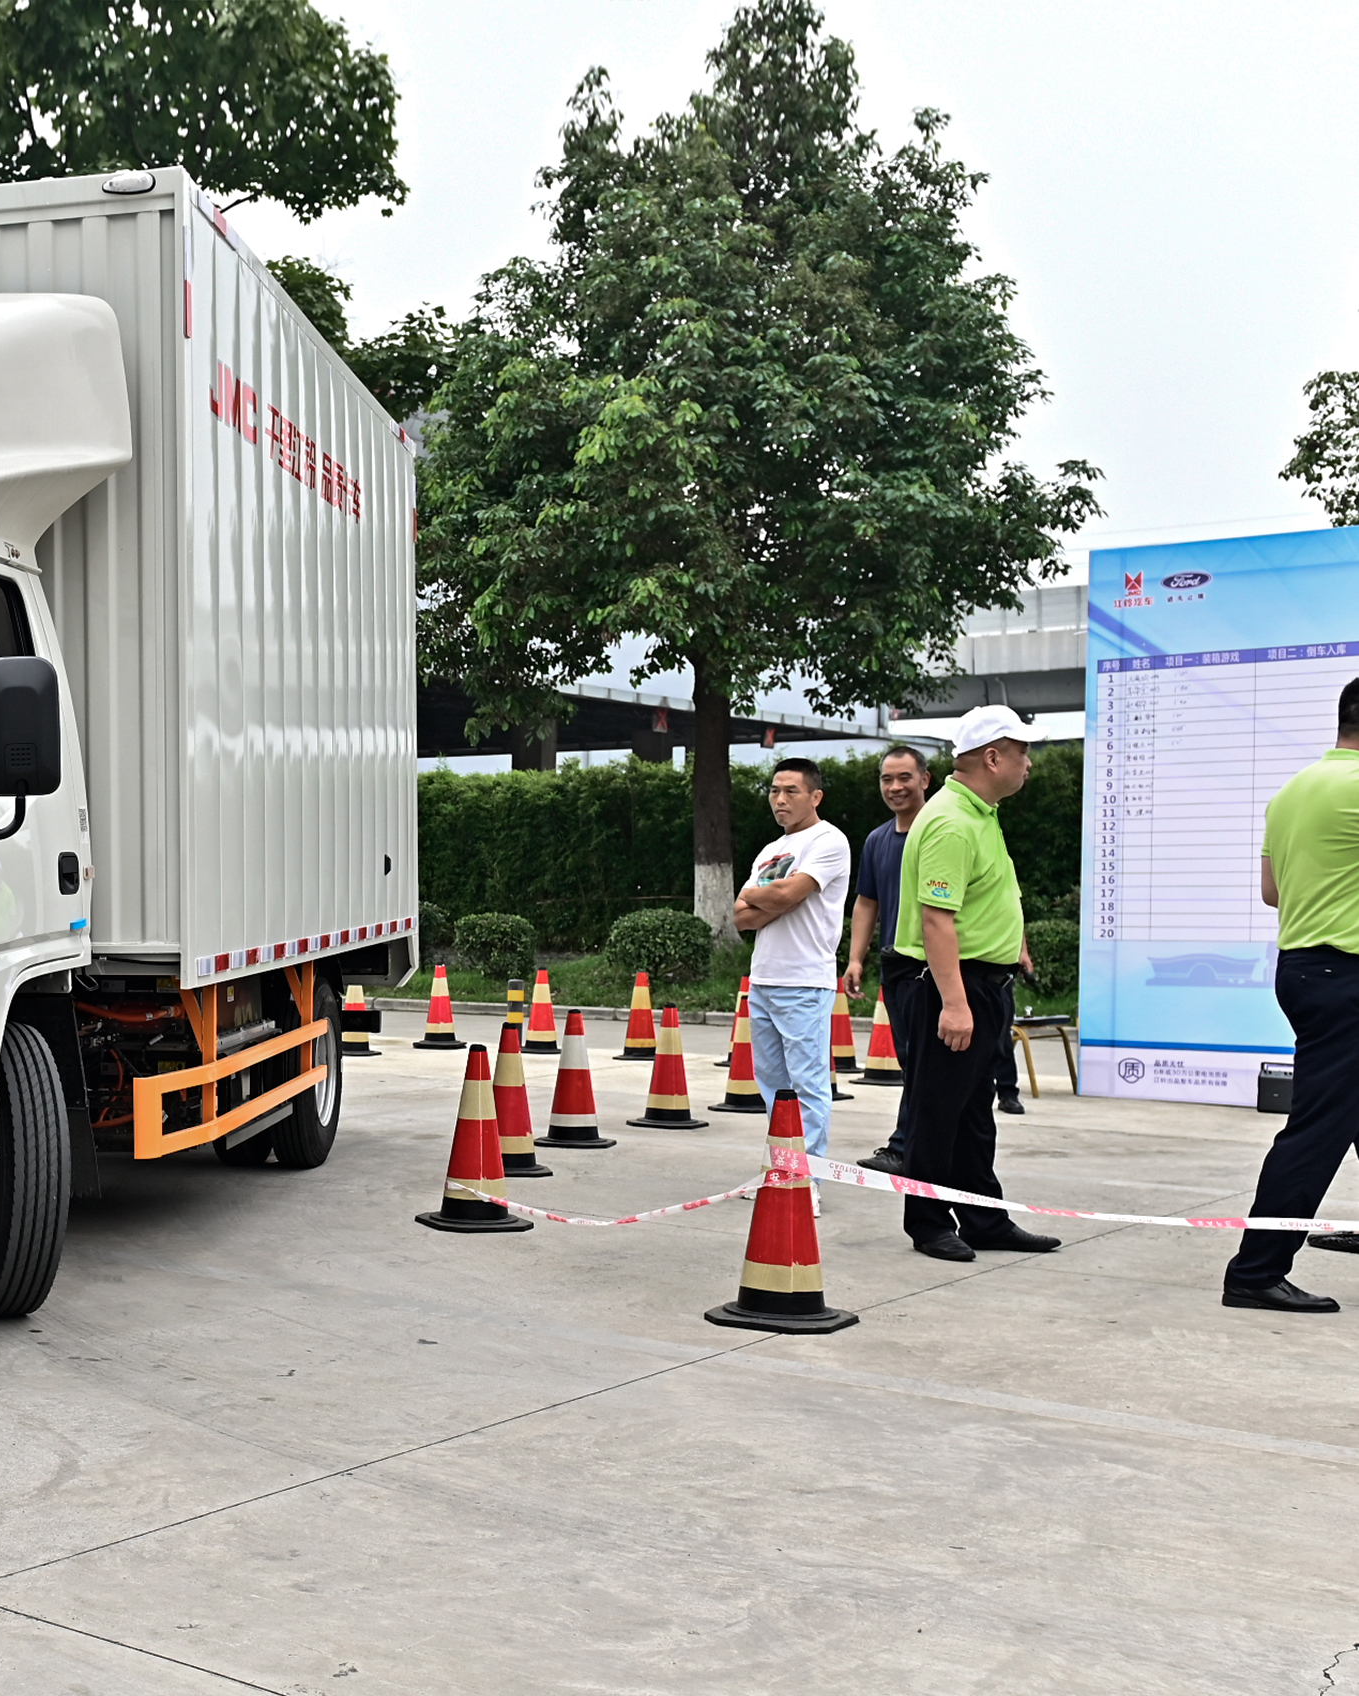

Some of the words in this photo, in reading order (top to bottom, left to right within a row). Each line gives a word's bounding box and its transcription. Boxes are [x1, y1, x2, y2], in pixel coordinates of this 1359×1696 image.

[209, 359, 258, 447] JMC
[1170, 574, 1201, 588] Ford
[1102, 660, 1120, 671] 序号
[1132, 658, 1150, 669] 姓名
[1108, 675, 1114, 683] 1
[1107, 688, 1114, 697] 2
[1107, 701, 1114, 710] 3
[1107, 714, 1114, 723] 4
[1107, 728, 1114, 737] 5
[1107, 741, 1114, 750] 6
[1107, 755, 1113, 764] 7
[1106, 768, 1113, 777] 8
[1106, 781, 1113, 791] 9
[1102, 795, 1116, 804] 10
[1102, 809, 1116, 817] 11
[1102, 822, 1116, 831] 12
[1102, 835, 1115, 844] 13
[1102, 849, 1115, 858] 14
[1101, 862, 1115, 871] 15
[1101, 875, 1115, 884] 16
[927, 880, 948, 889] JMC
[1101, 889, 1115, 898] 17
[1101, 902, 1114, 911] 18
[1100, 915, 1114, 925] 19
[1100, 929, 1114, 938] 20
